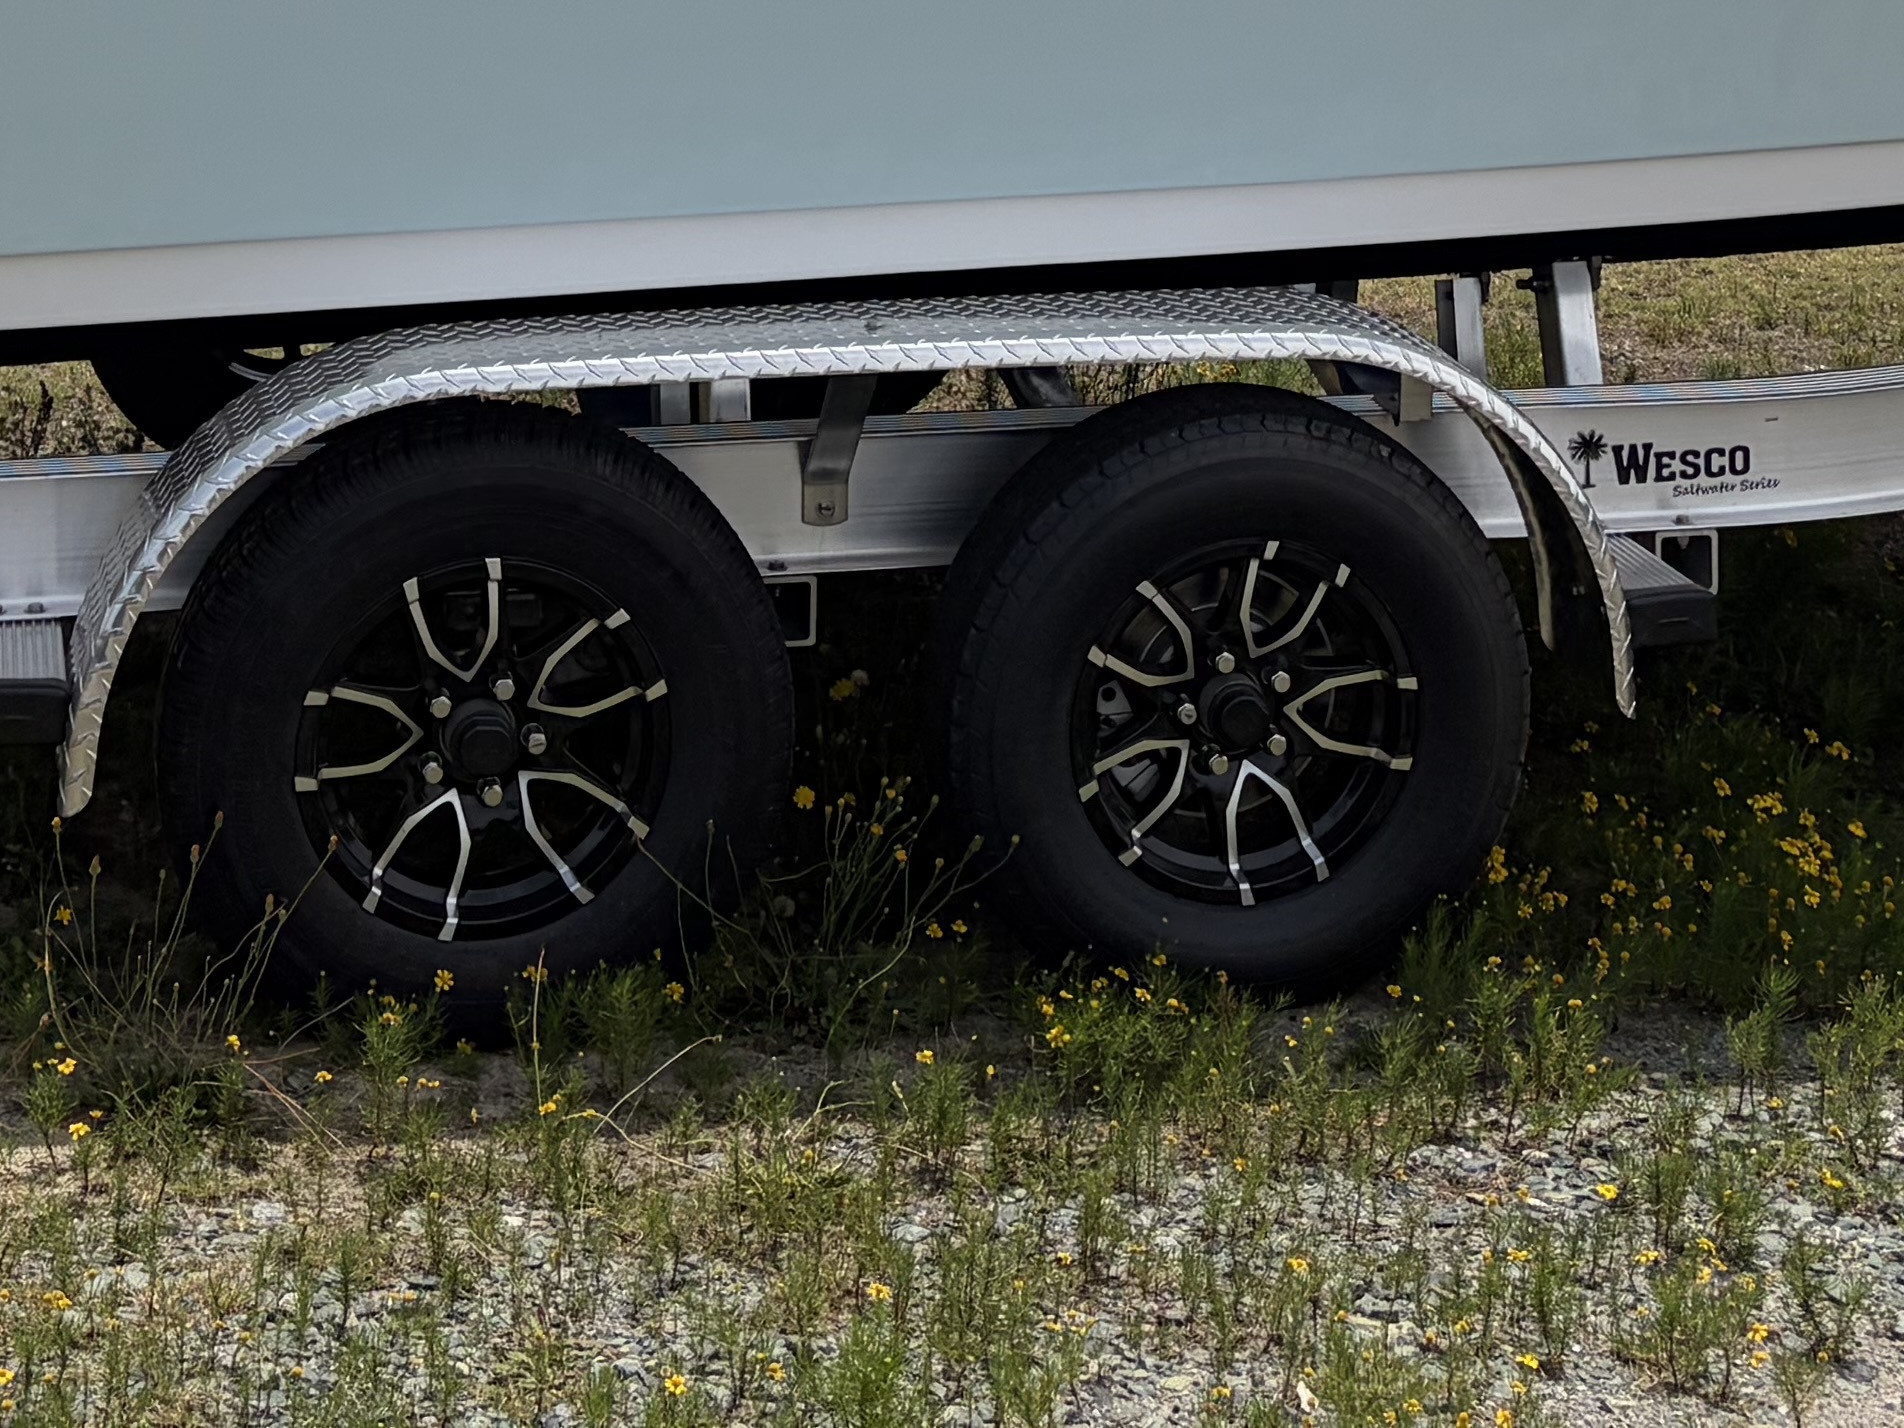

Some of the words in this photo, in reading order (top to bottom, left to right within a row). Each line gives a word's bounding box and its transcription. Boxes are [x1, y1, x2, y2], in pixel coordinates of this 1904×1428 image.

[1610, 442, 1751, 486] WESCO
[1671, 480, 1738, 499] Saltwater
[1738, 475, 1782, 493] Series
